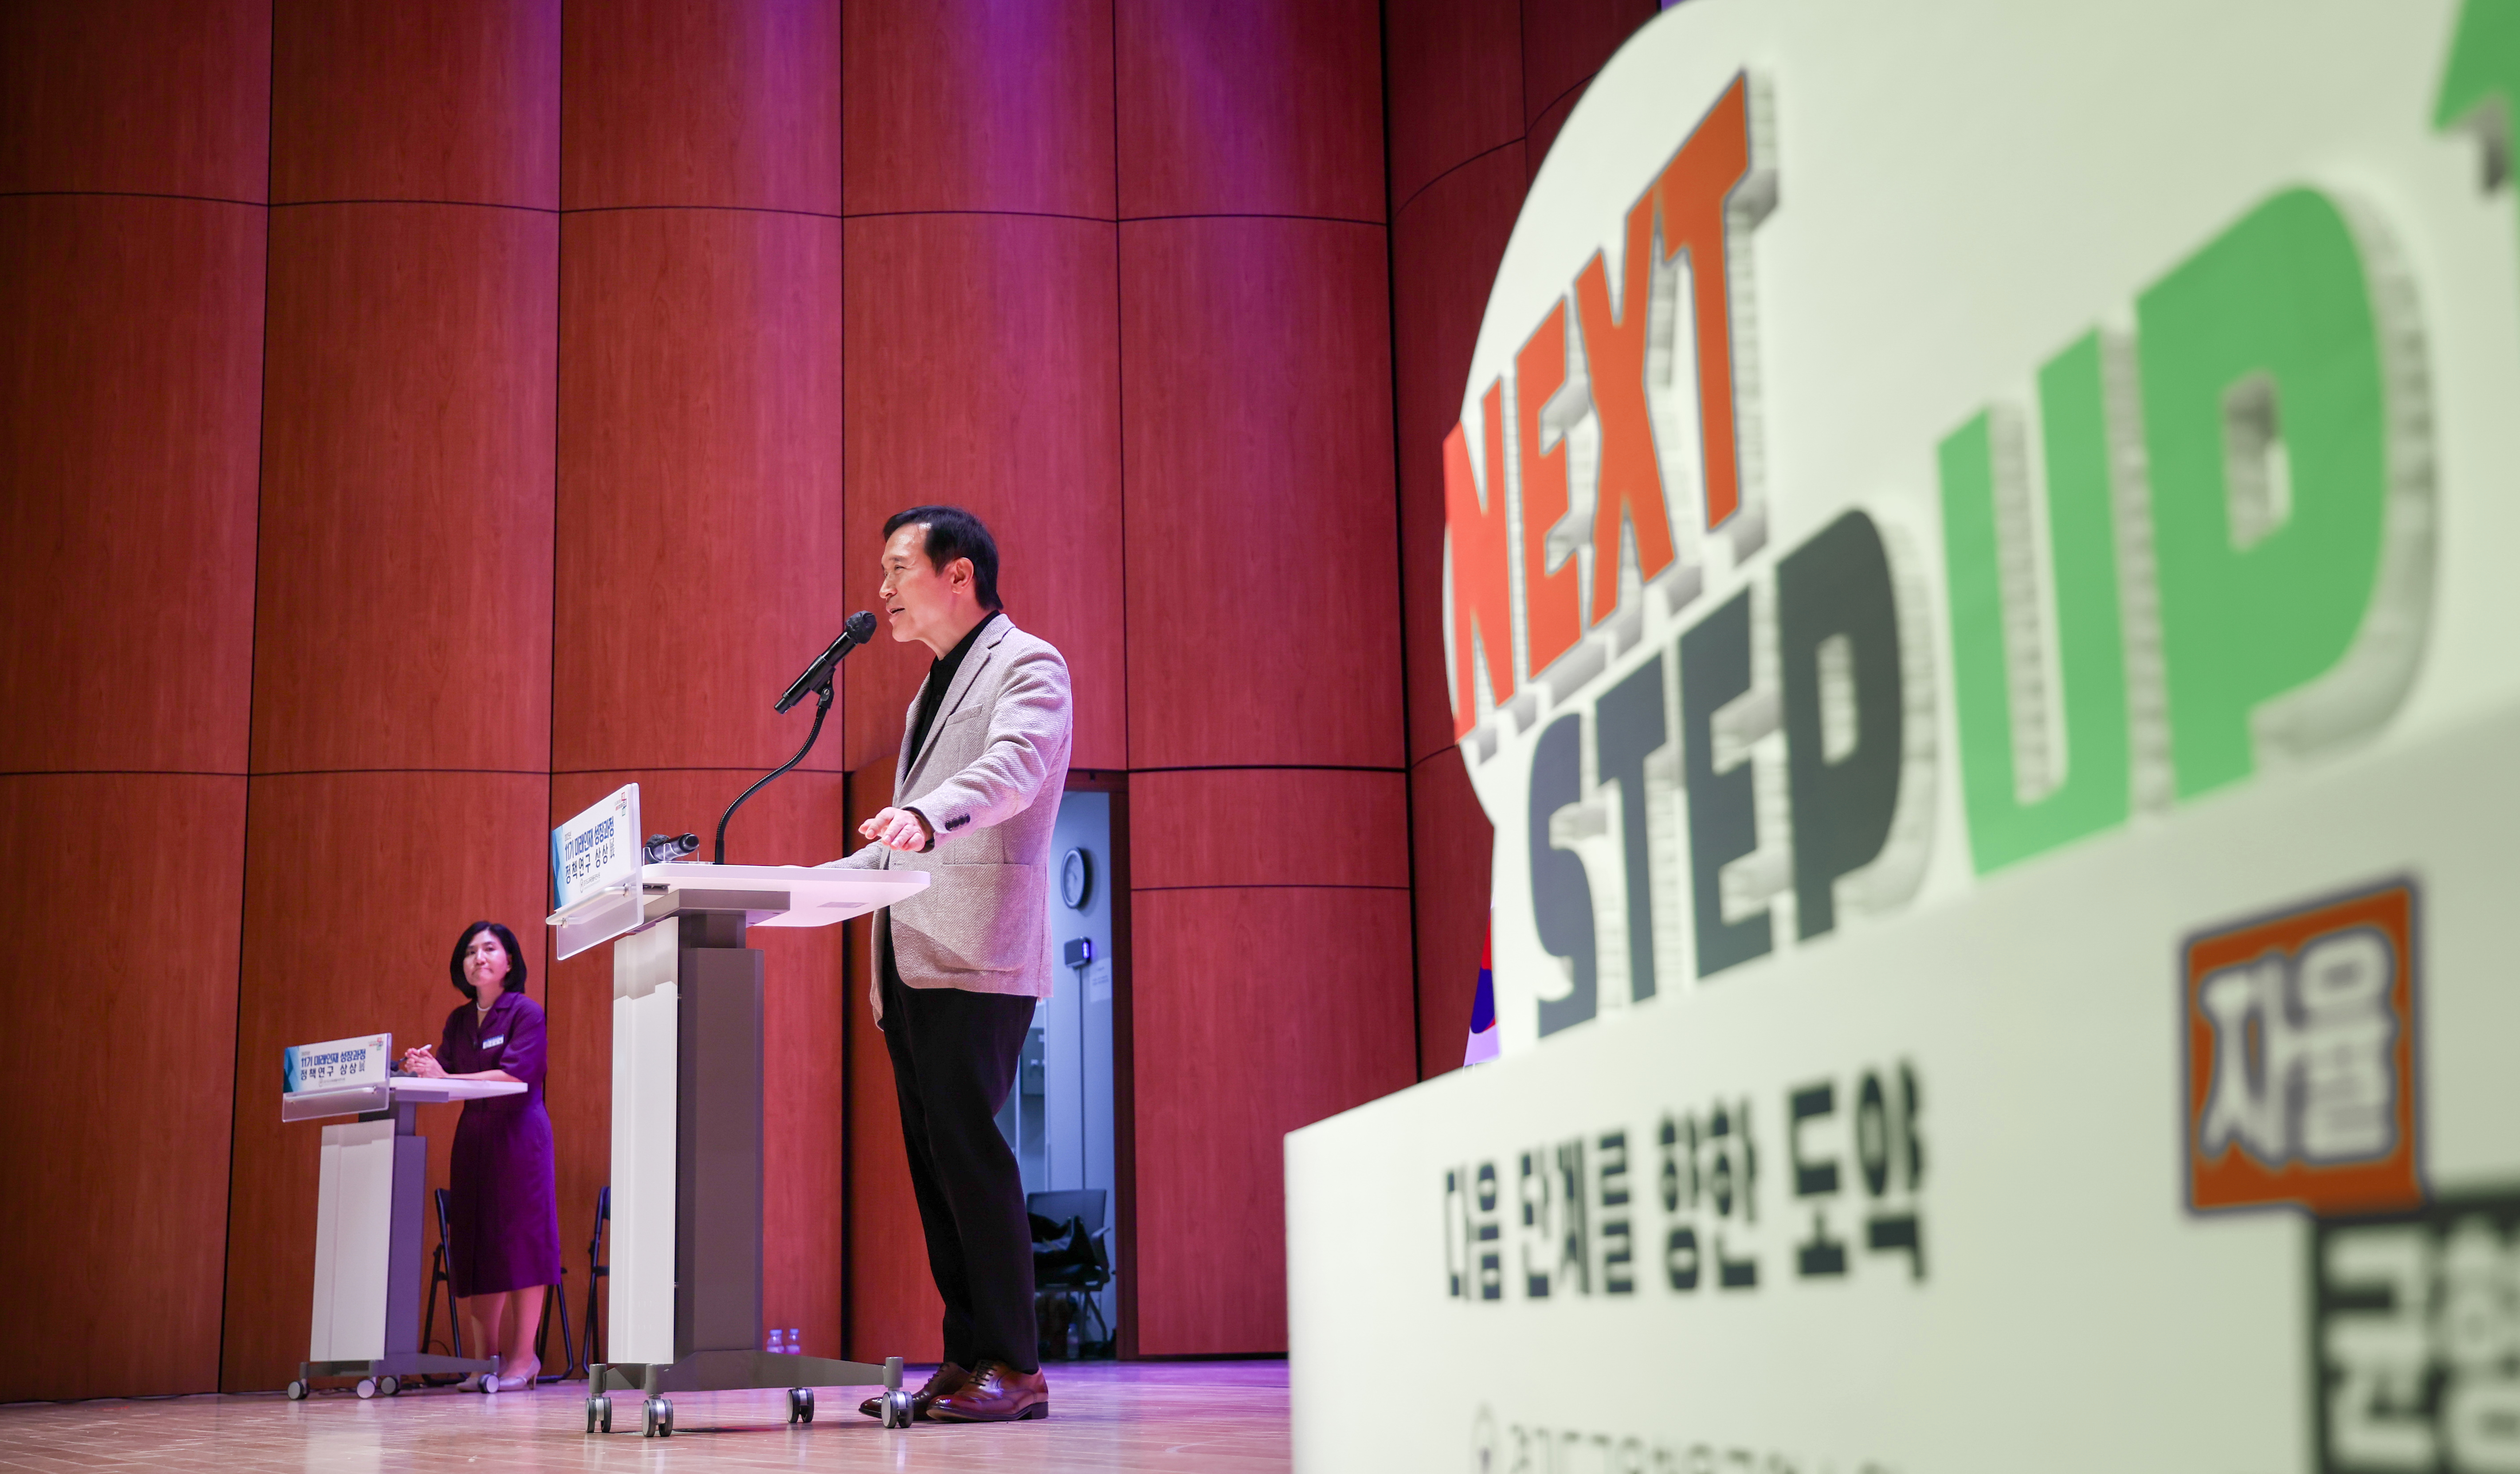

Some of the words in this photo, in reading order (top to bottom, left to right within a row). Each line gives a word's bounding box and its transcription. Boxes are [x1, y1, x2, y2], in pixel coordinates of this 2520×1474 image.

[1442, 67, 1754, 747] NEXT
[1528, 505, 1905, 1040] STEP
[1936, 177, 2392, 882] UP
[565, 839, 574, 862] 11기
[575, 828, 594, 856] 미래인재
[594, 815, 614, 846] 성장과정
[565, 853, 591, 884] 정책연구
[301, 1066, 333, 1081] 정책연구
[302, 1056, 313, 1067] 11기
[340, 1048, 366, 1063] 성장과정
[2197, 925, 2397, 1164] 자율
[1657, 1093, 1760, 1294] 향한
[1787, 1053, 1928, 1286] 도약
